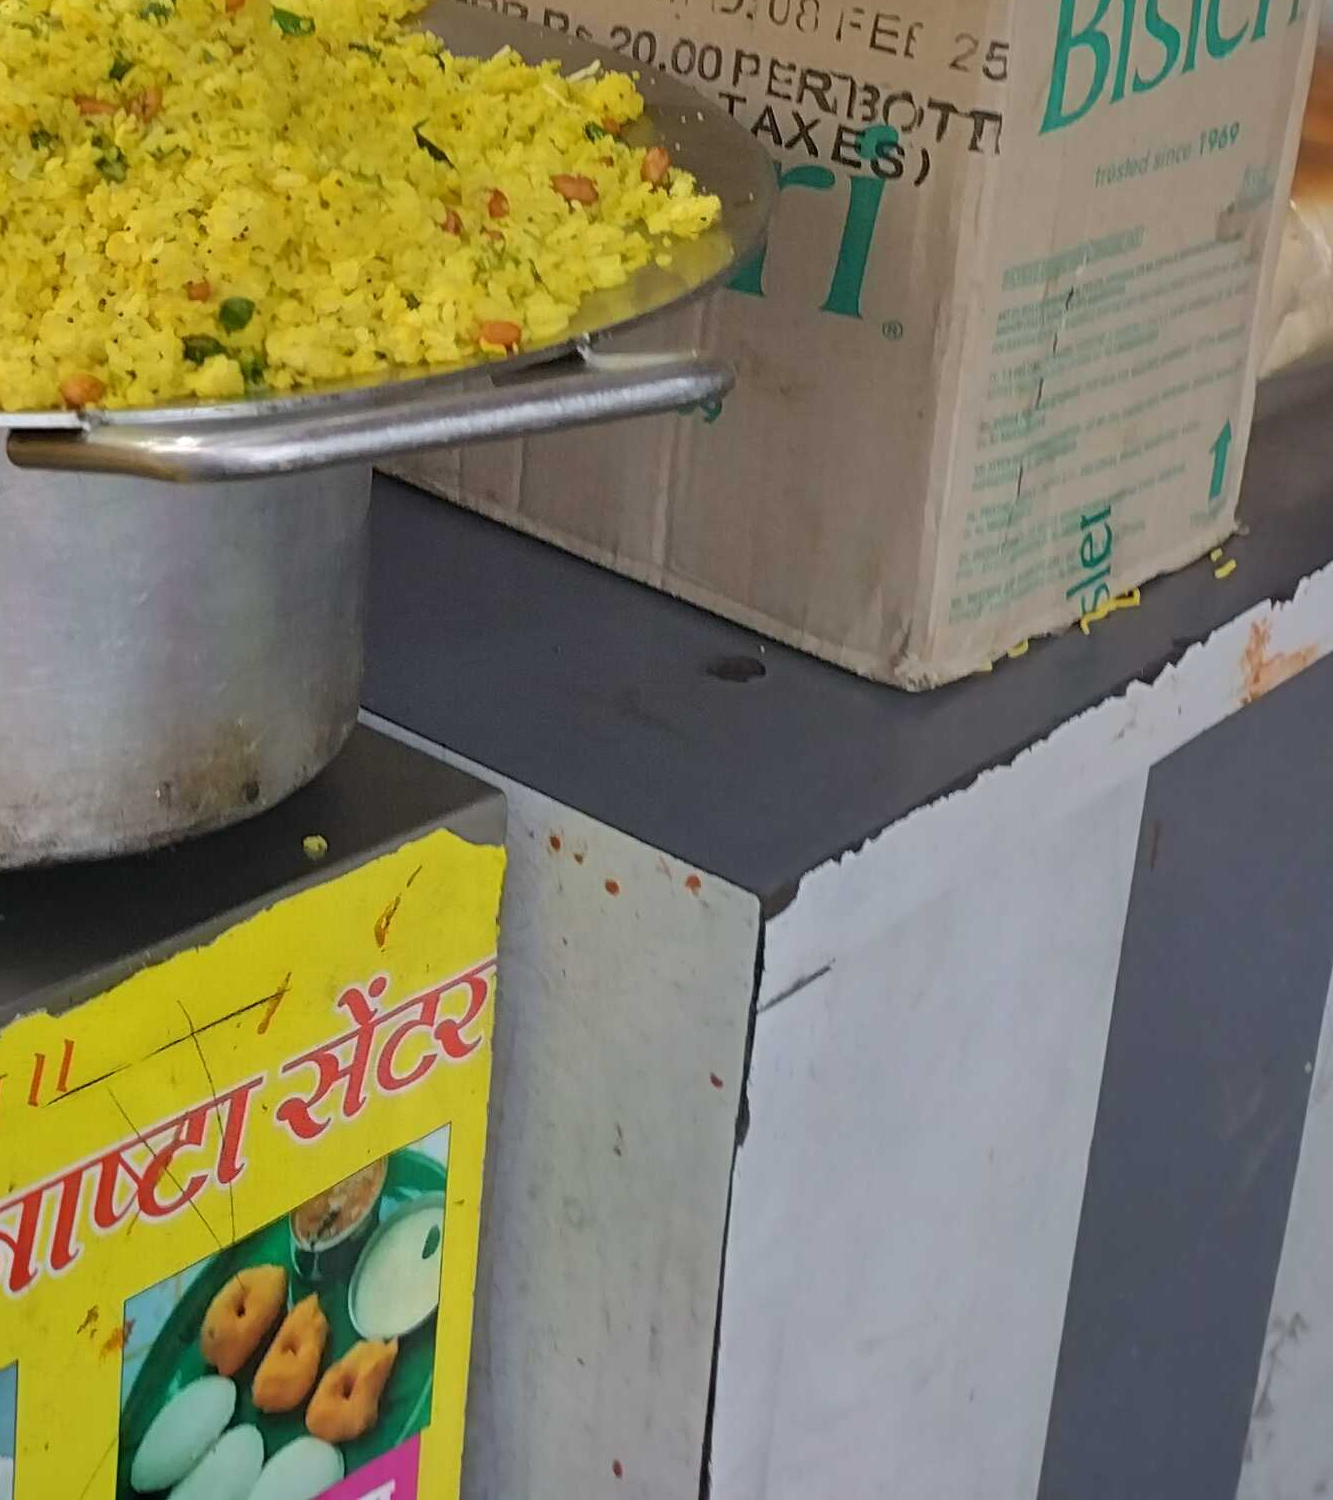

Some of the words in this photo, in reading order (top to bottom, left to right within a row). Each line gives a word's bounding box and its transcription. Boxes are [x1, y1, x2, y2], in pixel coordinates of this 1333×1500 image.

[948, 32, 1010, 81] 25
[1199, 121, 1240, 156] 1969
[273, 956, 497, 1140] सेंटर
